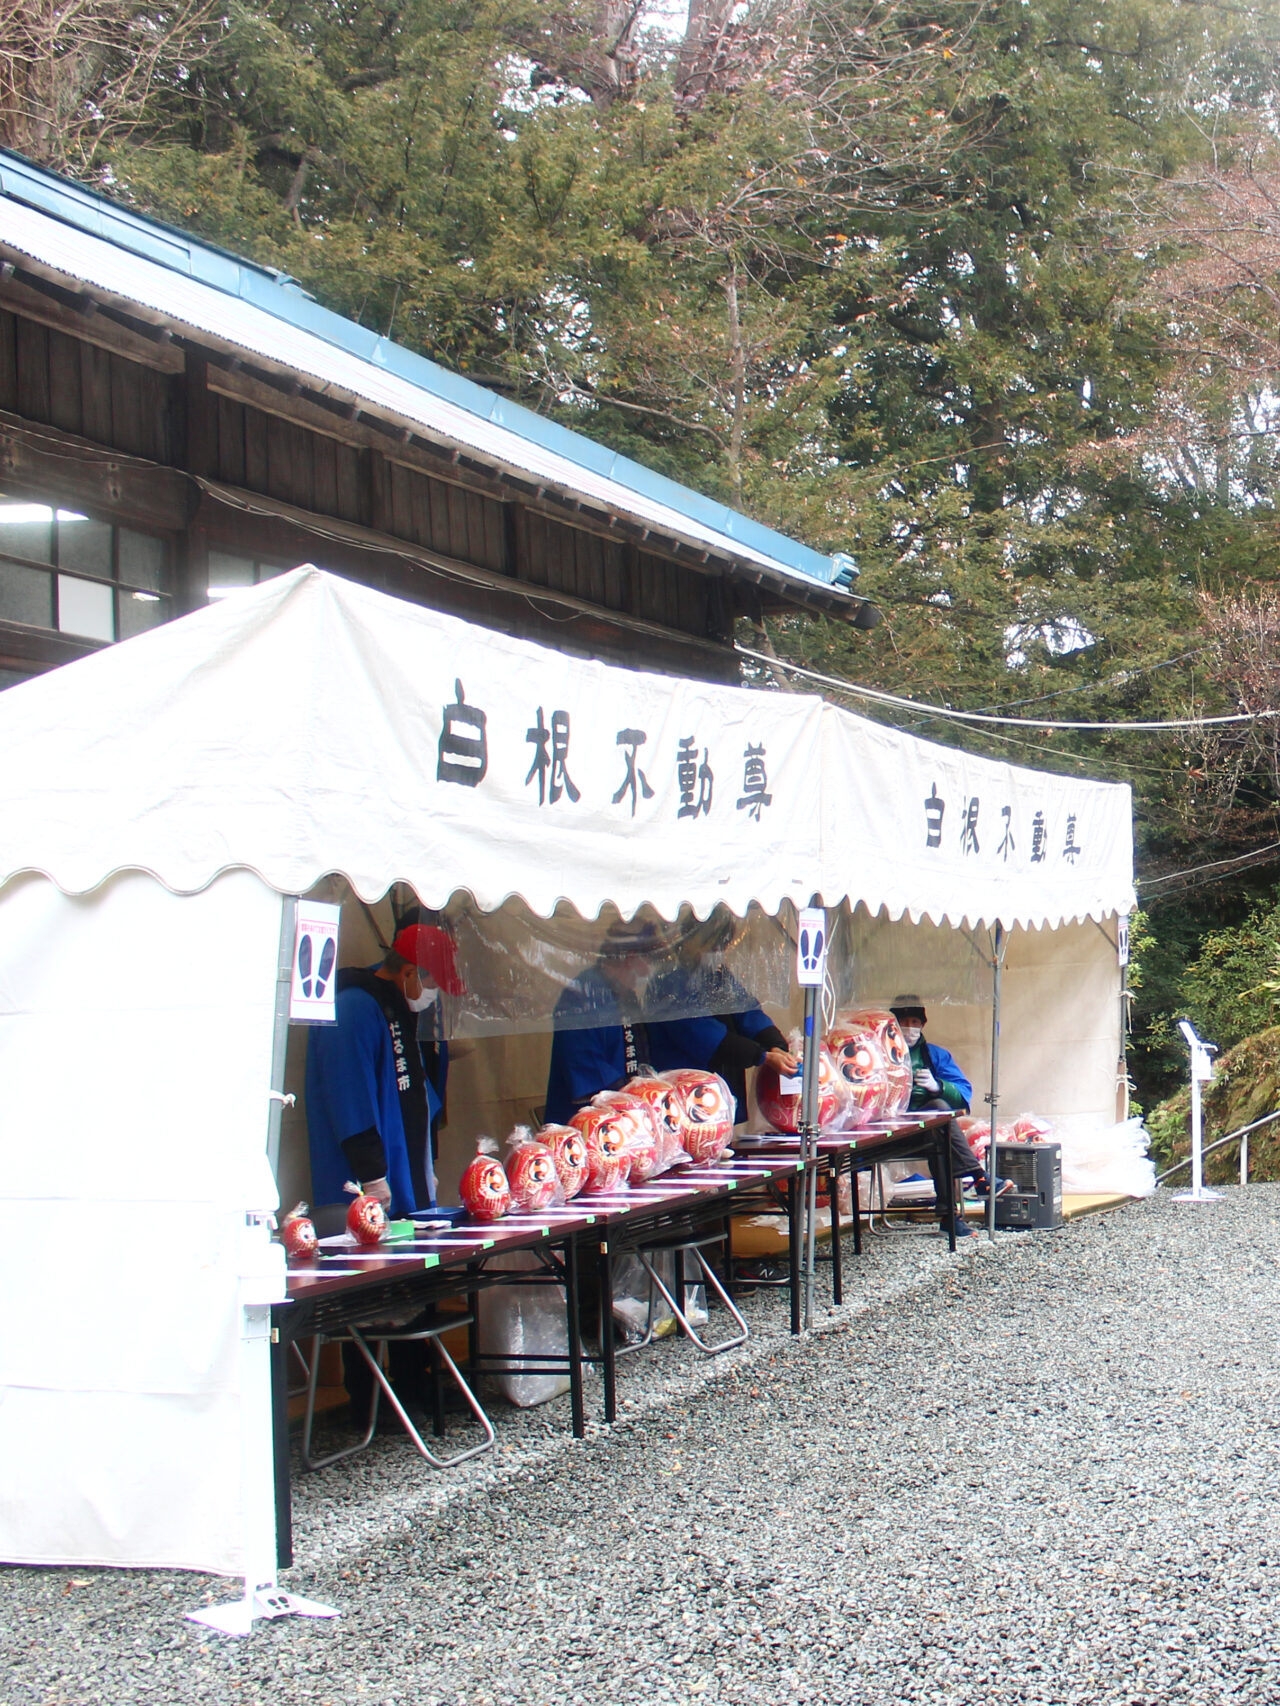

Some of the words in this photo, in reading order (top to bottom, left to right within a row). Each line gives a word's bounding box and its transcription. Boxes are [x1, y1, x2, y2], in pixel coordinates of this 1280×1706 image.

[437, 677, 773, 822] 白根不動尊
[924, 781, 1081, 865] 白根不動尊
